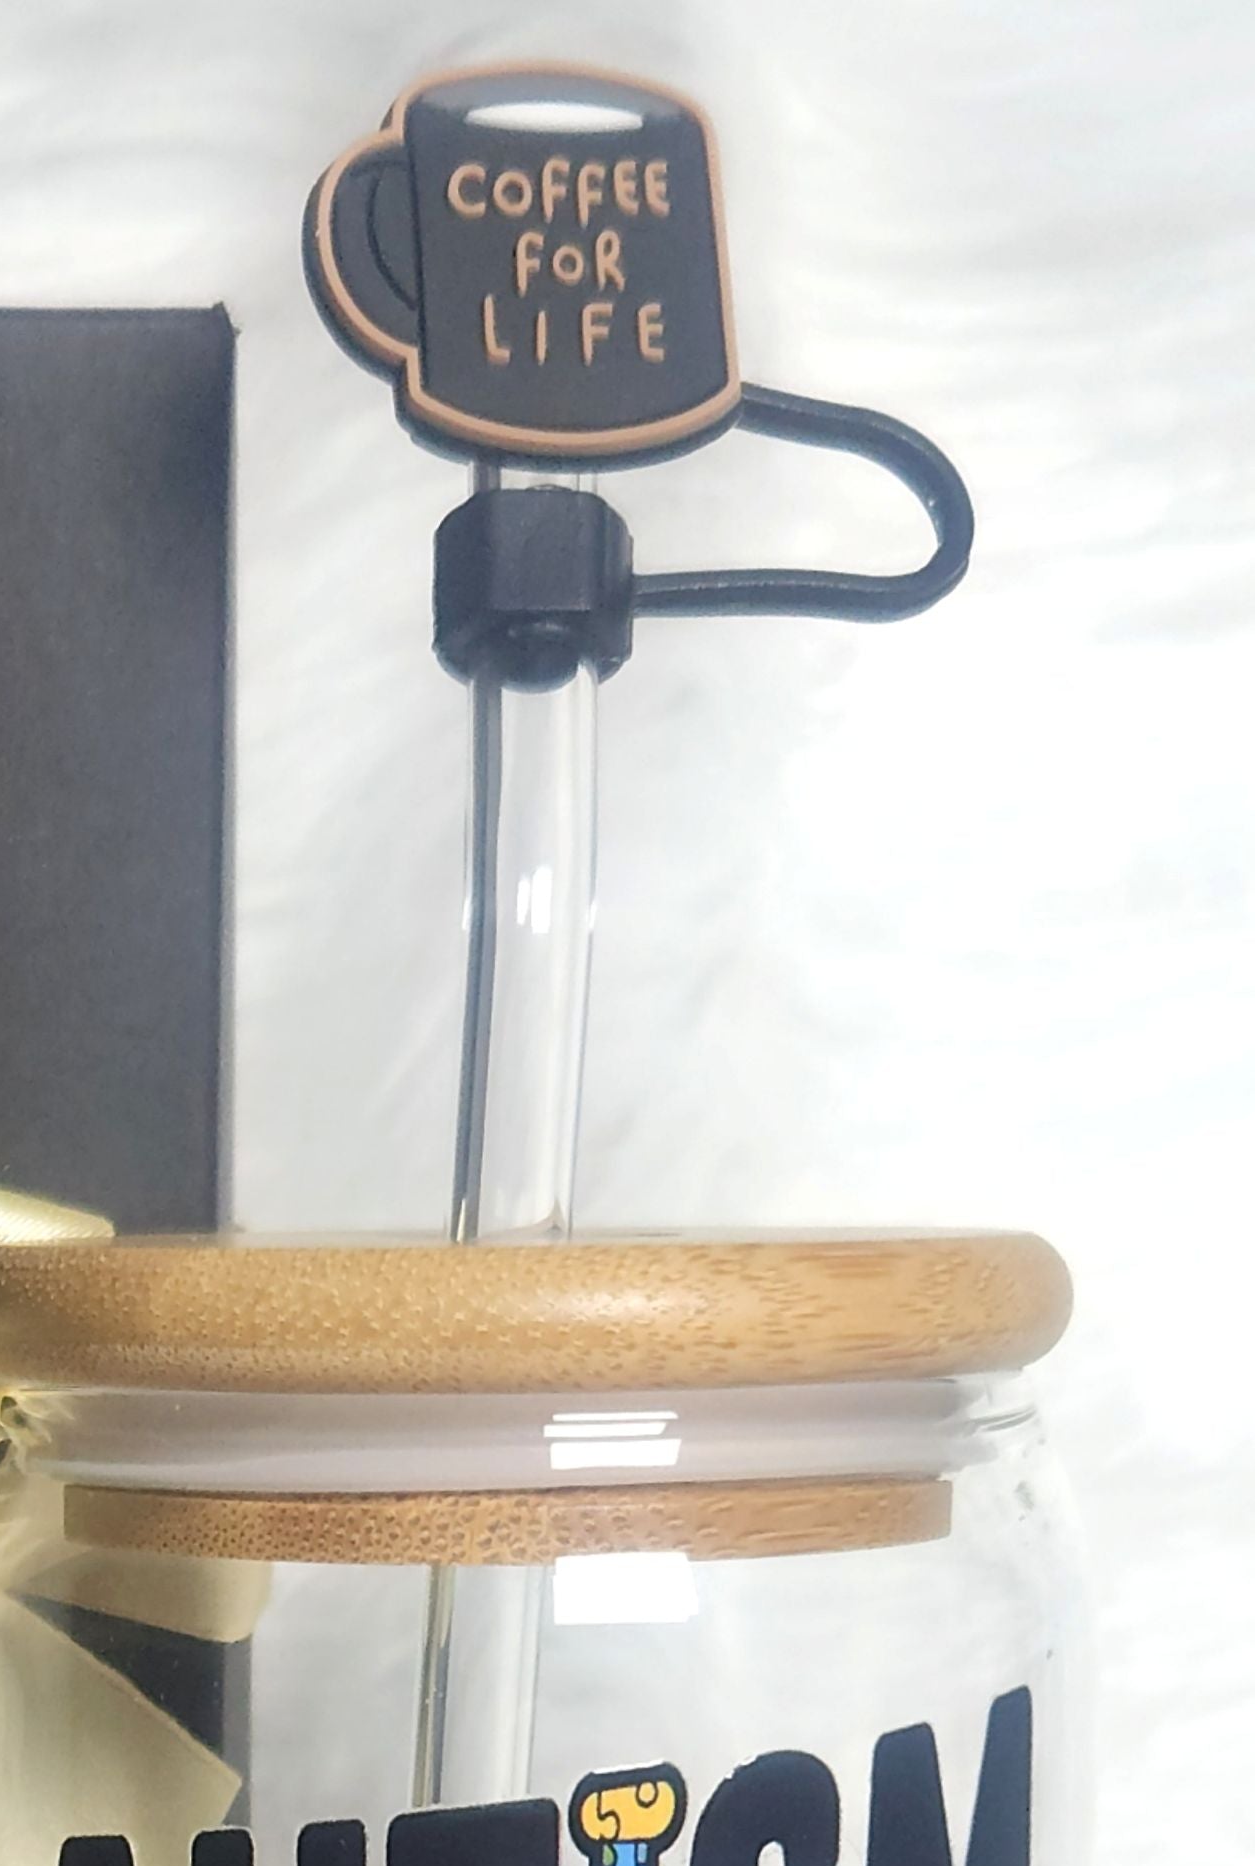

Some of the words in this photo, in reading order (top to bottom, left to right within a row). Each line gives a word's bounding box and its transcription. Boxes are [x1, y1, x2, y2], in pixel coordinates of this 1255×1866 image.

[448, 157, 670, 228] COFFEE
[515, 231, 625, 294] FOR
[483, 294, 665, 365] LIFE
